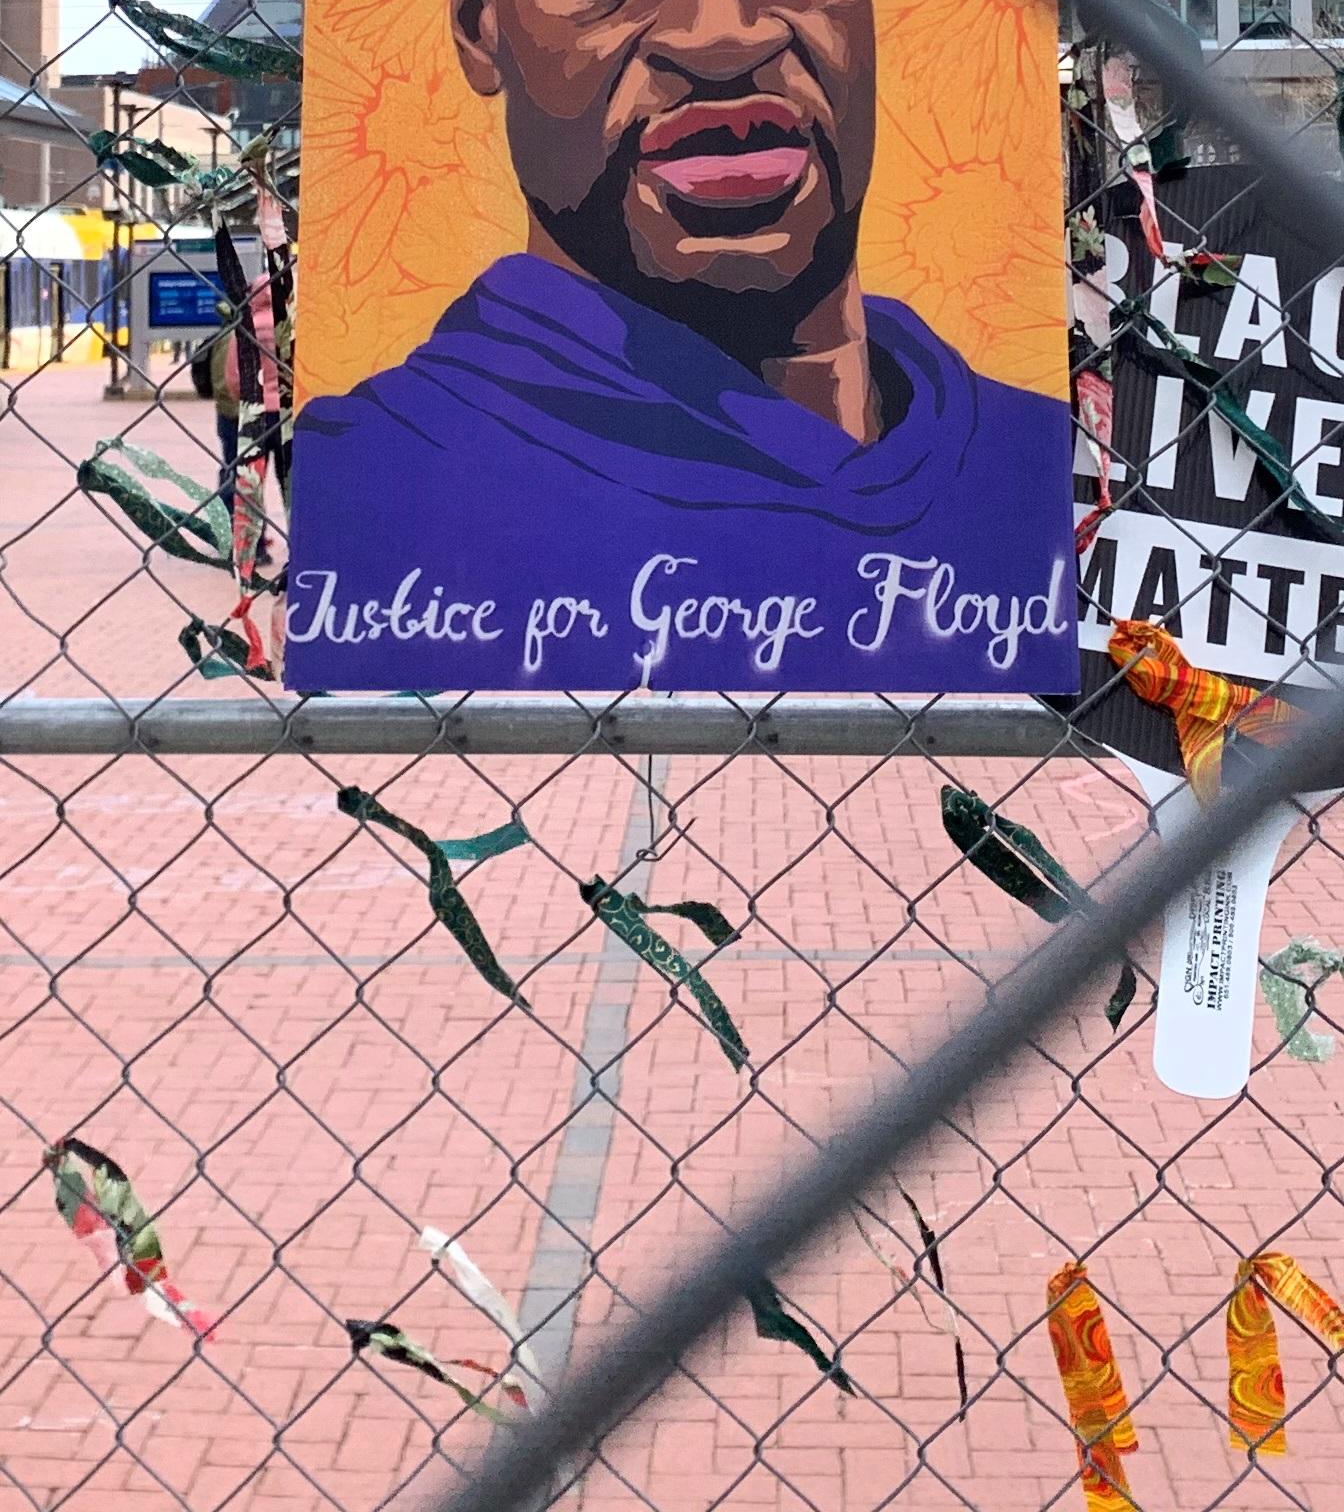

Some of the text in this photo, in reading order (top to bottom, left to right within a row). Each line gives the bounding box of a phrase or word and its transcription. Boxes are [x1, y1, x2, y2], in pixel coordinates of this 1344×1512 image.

[285, 551, 1069, 672] Justice for George Floyd
[1207, 870, 1227, 1010] IMPACT PRINTING
